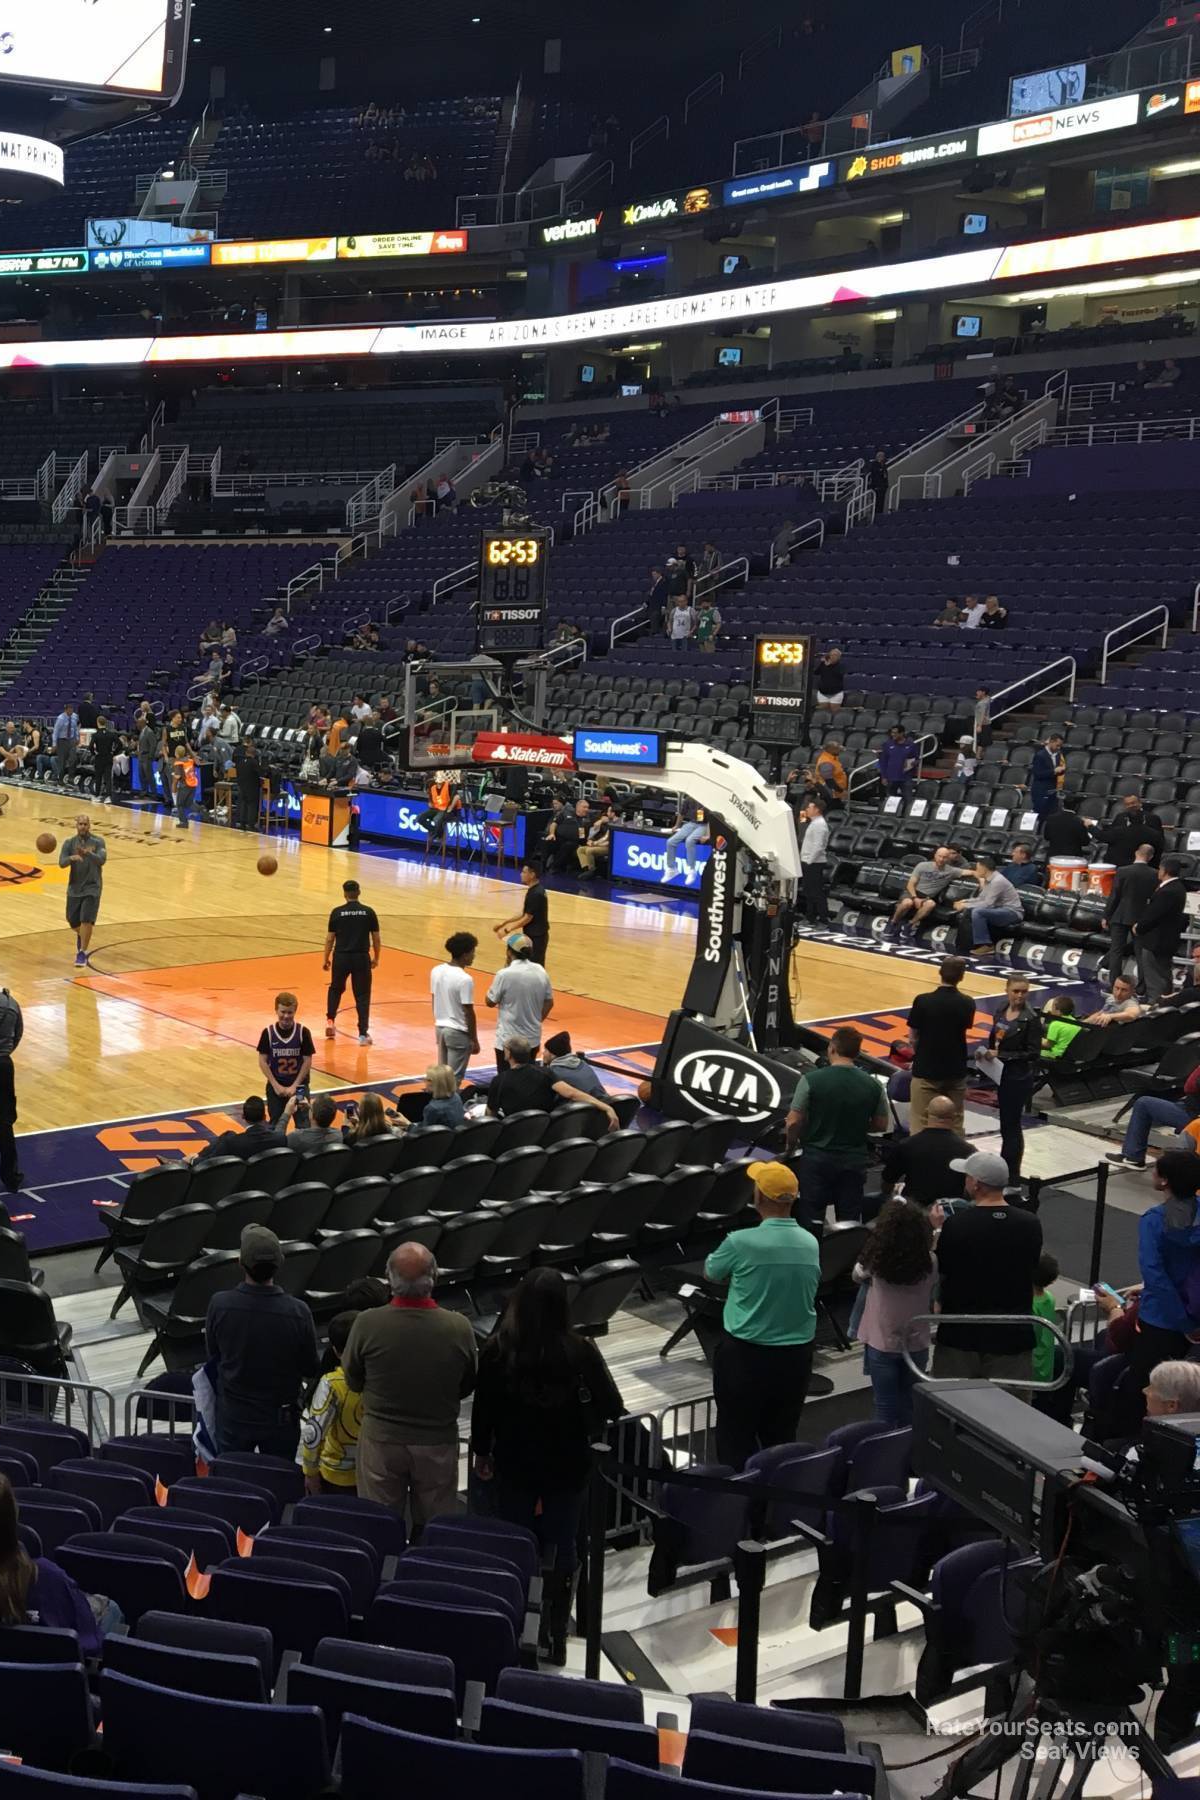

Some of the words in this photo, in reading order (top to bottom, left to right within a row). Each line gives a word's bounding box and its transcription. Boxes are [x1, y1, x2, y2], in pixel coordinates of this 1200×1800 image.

[1056, 110, 1100, 131] NEWS
[543, 217, 597, 242] verizon
[62, 256, 79, 268] FM
[124, 259, 132, 267] of
[132, 259, 162, 267] Arizona
[421, 328, 468, 340] IMAGE
[489, 540, 538, 564] 62:53
[761, 643, 804, 665] 62:53
[583, 738, 640, 756] Southwest
[728, 793, 763, 831] SPALDING
[704, 850, 728, 963] Southwest
[1061, 948, 1083, 966] G
[272, 1047, 301, 1057] PHOENIX
[277, 1058, 298, 1075] 22
[690, 1058, 759, 1104] KIA
